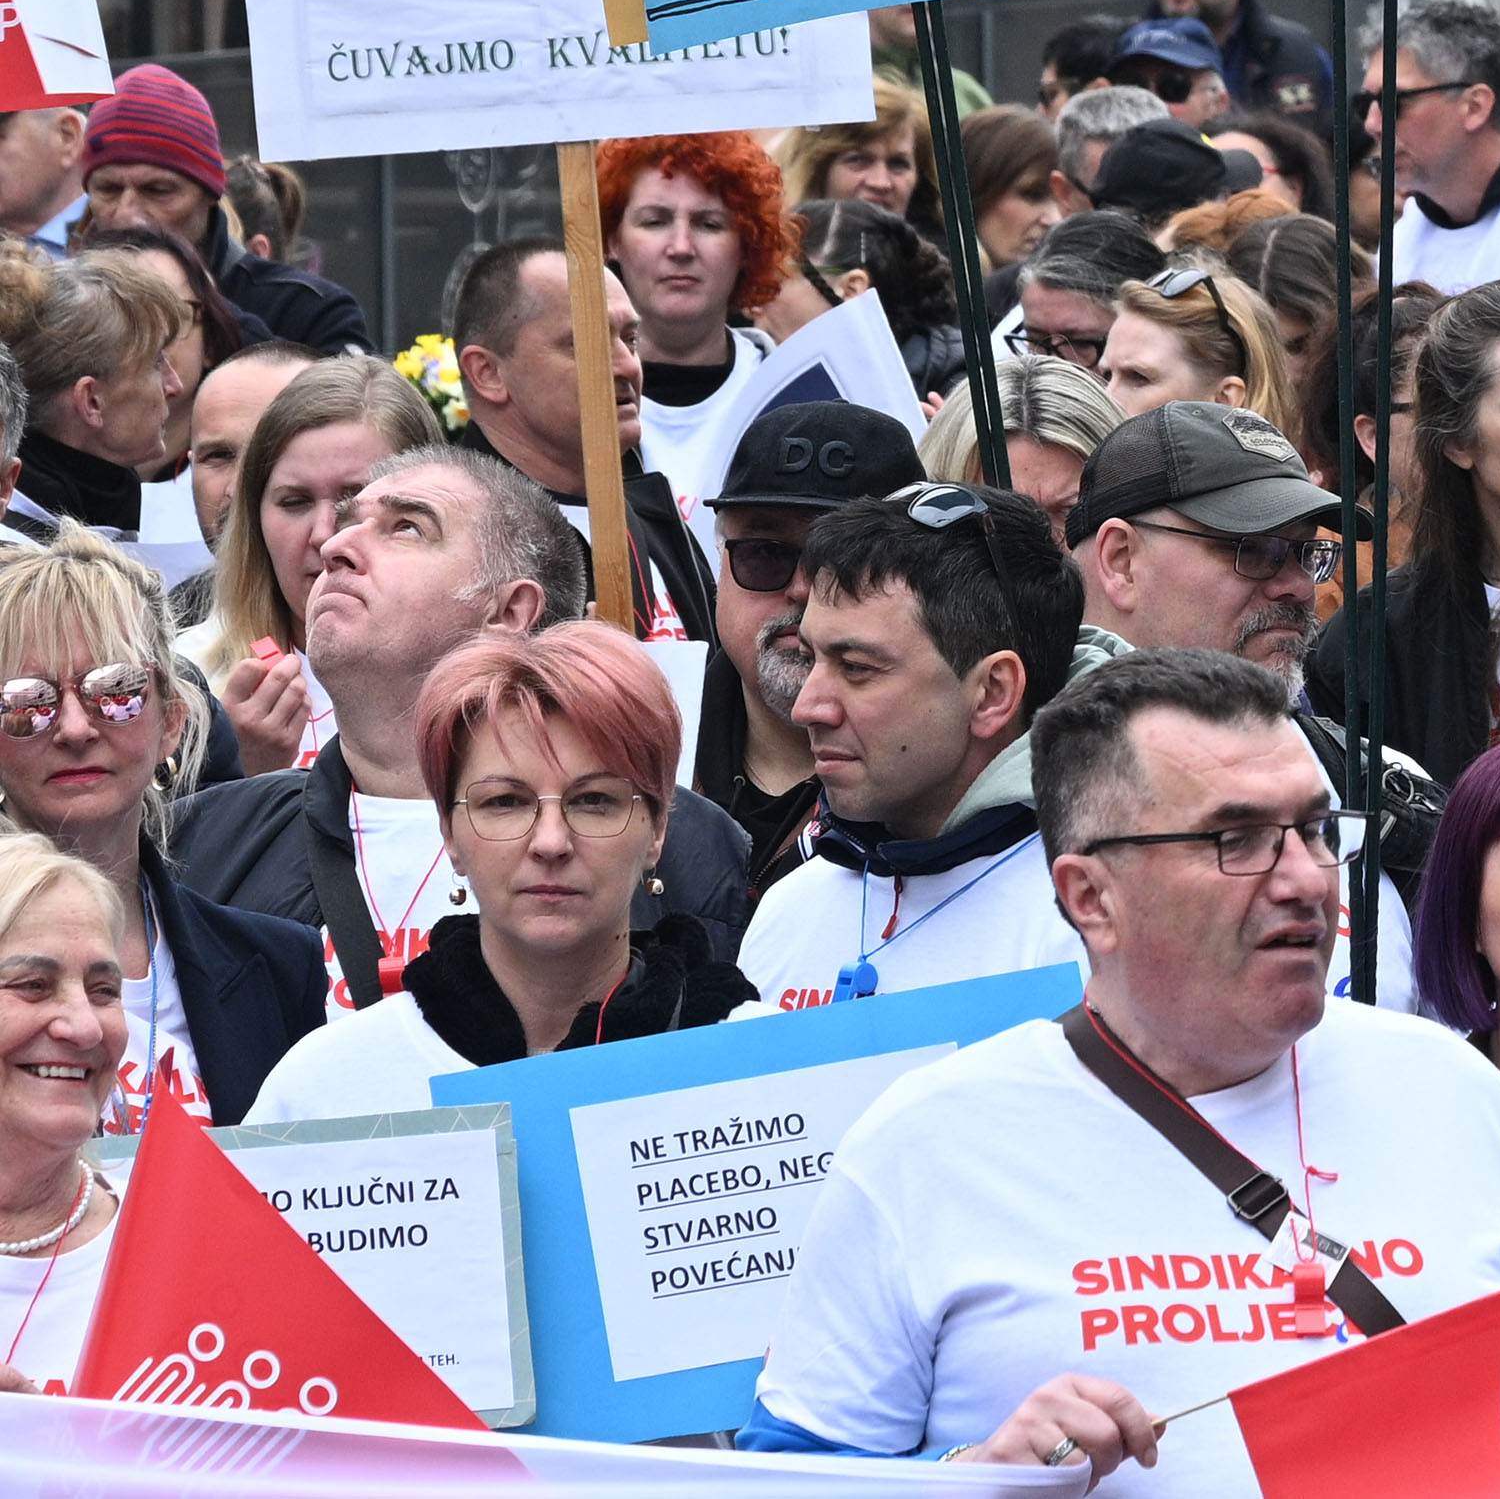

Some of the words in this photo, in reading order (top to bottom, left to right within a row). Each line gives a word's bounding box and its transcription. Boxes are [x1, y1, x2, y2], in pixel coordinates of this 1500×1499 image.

[327, 40, 516, 83] ČUVAJMO
[777, 436, 856, 478] DC
[629, 1138, 667, 1163] NE
[673, 1112, 805, 1153] TRAŽIMO
[303, 1177, 414, 1210] KLJUČNI
[423, 1178, 459, 1201] ZA
[636, 1165, 772, 1206] PLACEBO,
[307, 1224, 428, 1254] BUDIMO
[643, 1206, 778, 1249] STVARNO
[650, 1246, 800, 1294] POVEĆANJ
[428, 1353, 460, 1367] TEH.
